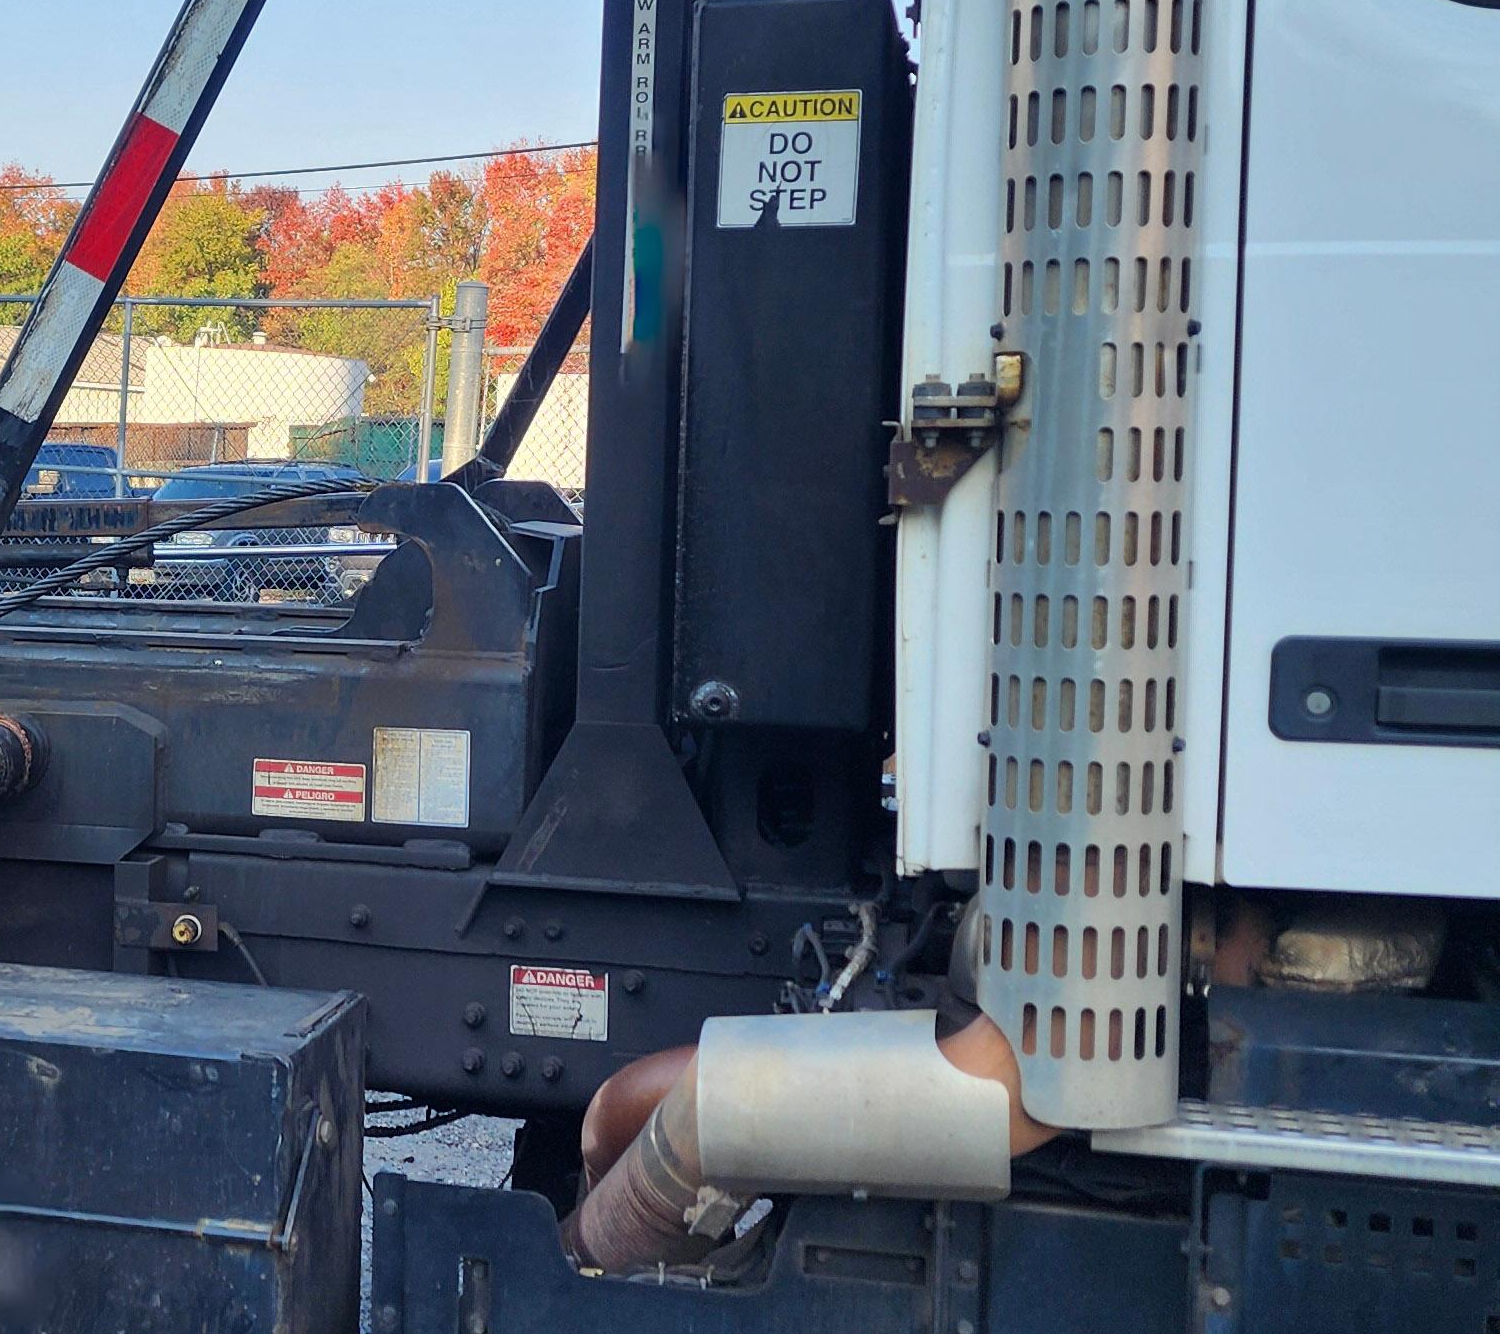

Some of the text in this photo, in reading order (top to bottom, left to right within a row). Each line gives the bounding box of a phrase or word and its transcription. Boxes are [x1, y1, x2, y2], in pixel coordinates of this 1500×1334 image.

[636, 22, 651, 65] ARM
[749, 97, 853, 118] CAUTION
[769, 131, 813, 155] DO
[758, 160, 822, 183] NOT
[749, 188, 827, 212] STEP
[296, 765, 335, 775] DANGER
[295, 790, 335, 801] PELIGRO
[536, 971, 595, 988] DANGER
